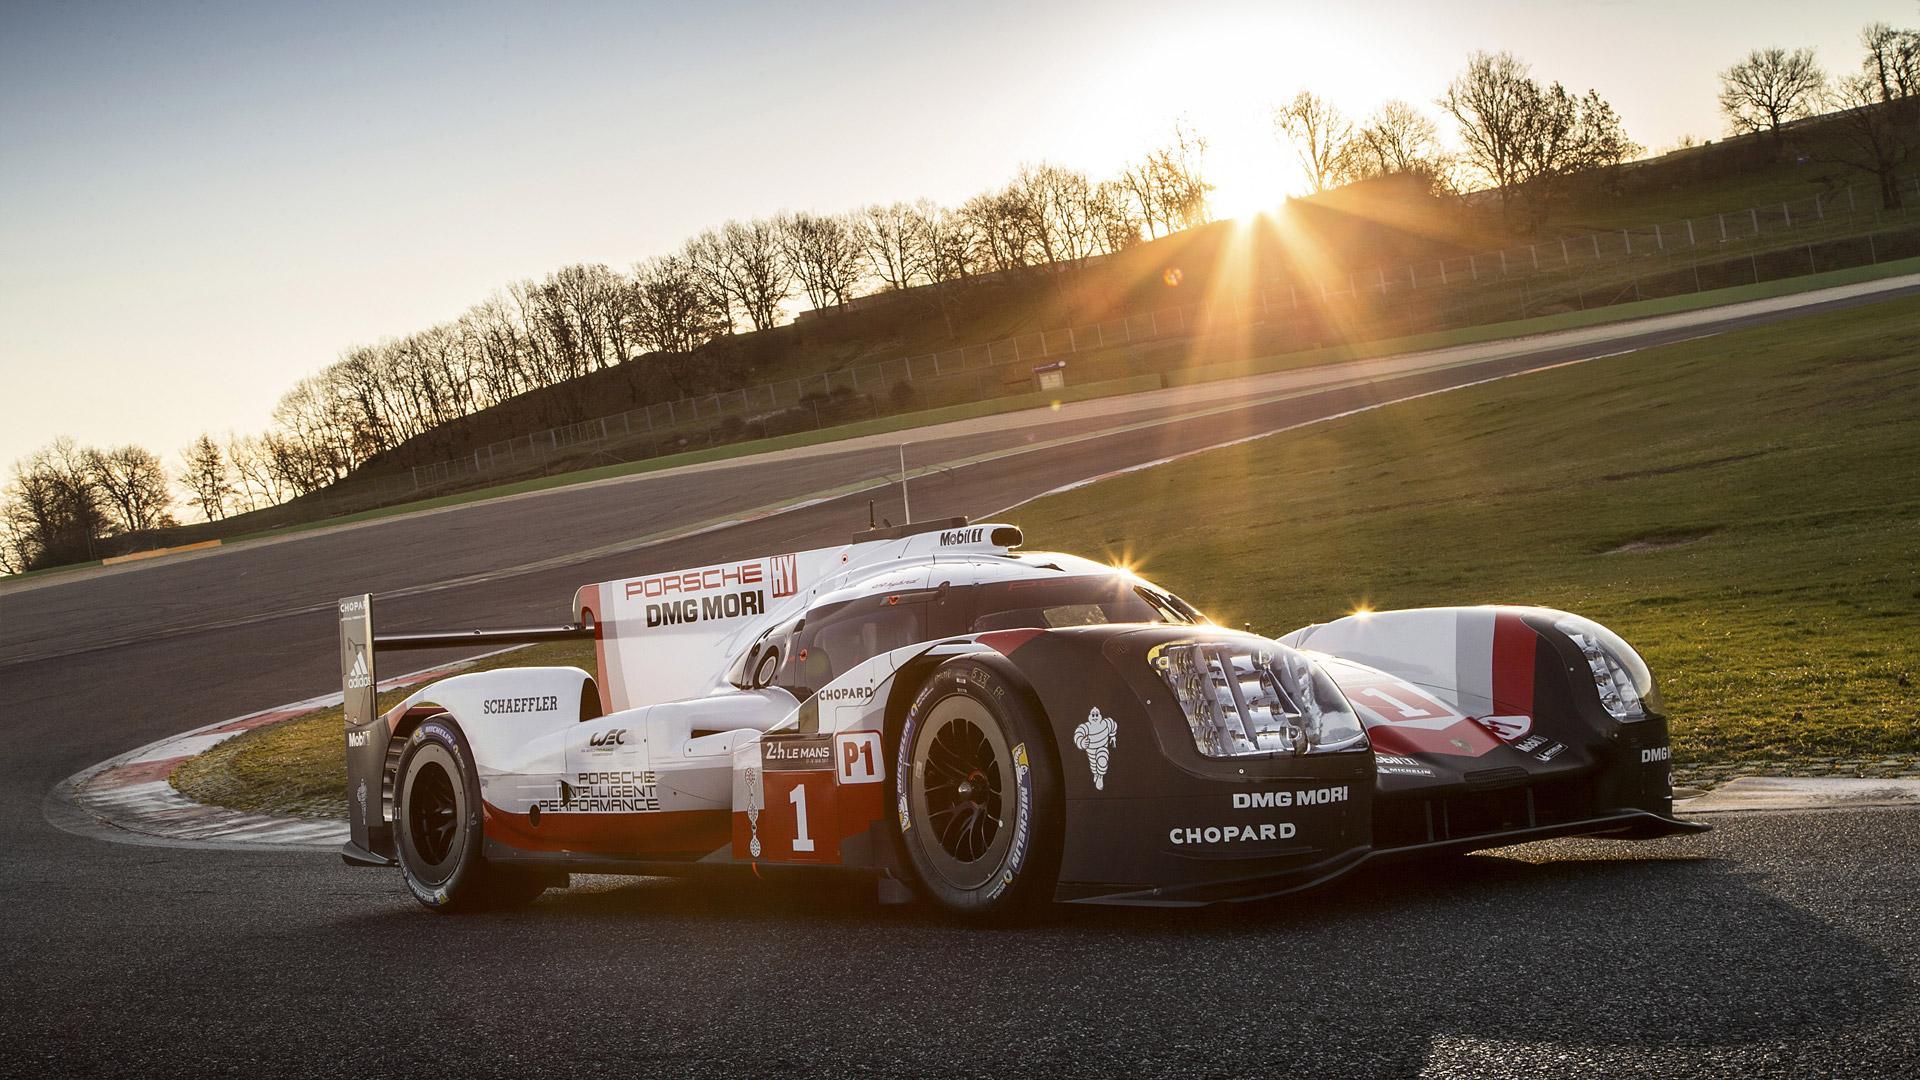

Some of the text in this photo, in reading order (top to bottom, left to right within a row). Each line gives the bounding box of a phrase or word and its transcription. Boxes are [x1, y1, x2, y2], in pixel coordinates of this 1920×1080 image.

[625, 563, 763, 600] PORSCHE
[770, 554, 798, 598] HY
[646, 590, 765, 628] DMG MORI
[483, 695, 558, 714] SCHAEFFLER
[819, 687, 873, 701] CHOPARD
[1361, 687, 1431, 718] 1
[425, 725, 453, 744] MICHELIN
[589, 728, 627, 747] WEC
[787, 748, 799, 759] LE
[800, 747, 830, 758] MANS
[843, 740, 875, 777] P1
[896, 717, 911, 794] MICHELIN
[1641, 747, 1667, 763] DMG
[578, 770, 655, 785] PORSCHE
[1389, 767, 1431, 775] MICHELIN
[538, 798, 661, 812] PERFORMANCE
[1233, 786, 1349, 809] DMG MORI
[789, 783, 815, 852] 1
[1011, 786, 1029, 869] MICHELIN
[1169, 823, 1296, 845] CHOPARD
